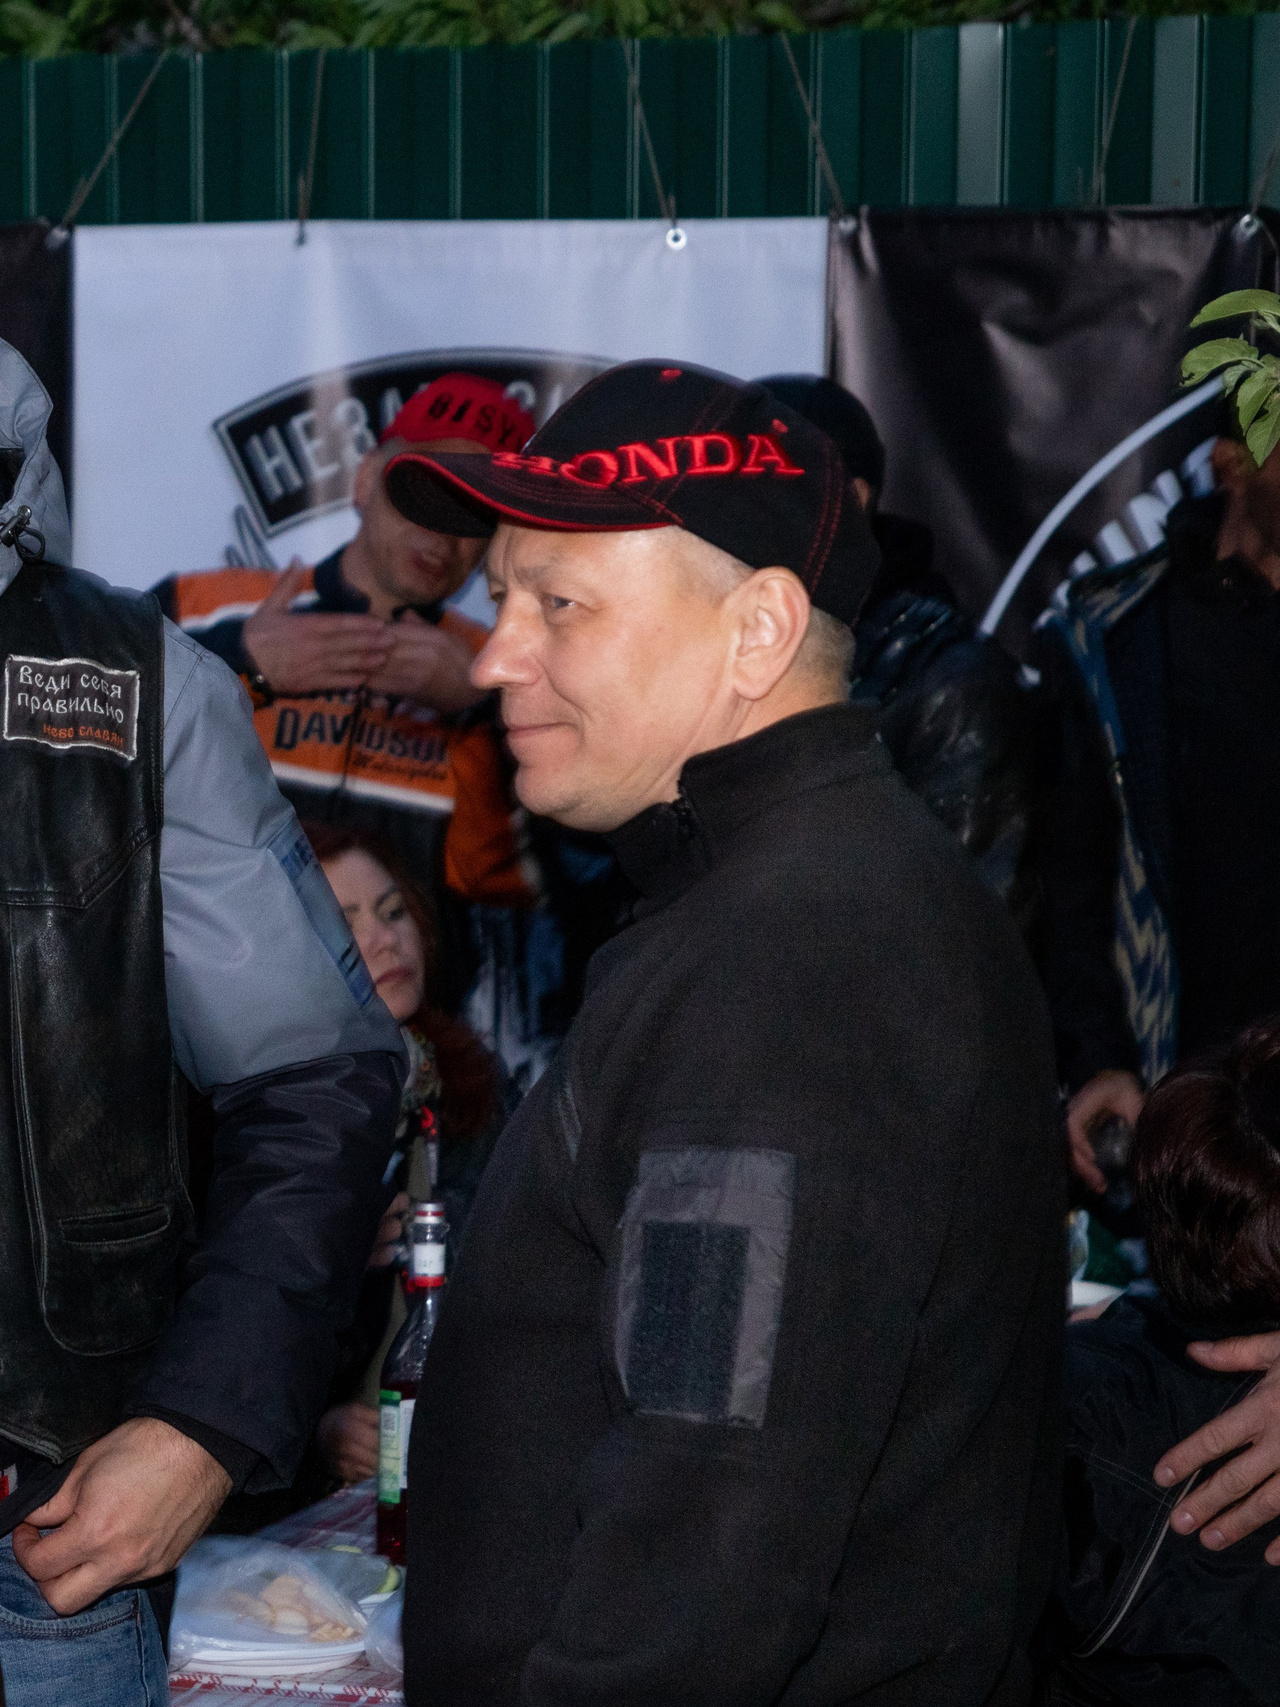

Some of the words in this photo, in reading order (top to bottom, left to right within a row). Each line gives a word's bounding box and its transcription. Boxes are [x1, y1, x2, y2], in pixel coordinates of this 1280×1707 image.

[492, 432, 806, 489] HONDA
[19, 664, 71, 695] Веди
[79, 673, 122, 700] себя
[17, 692, 124, 724] правильно
